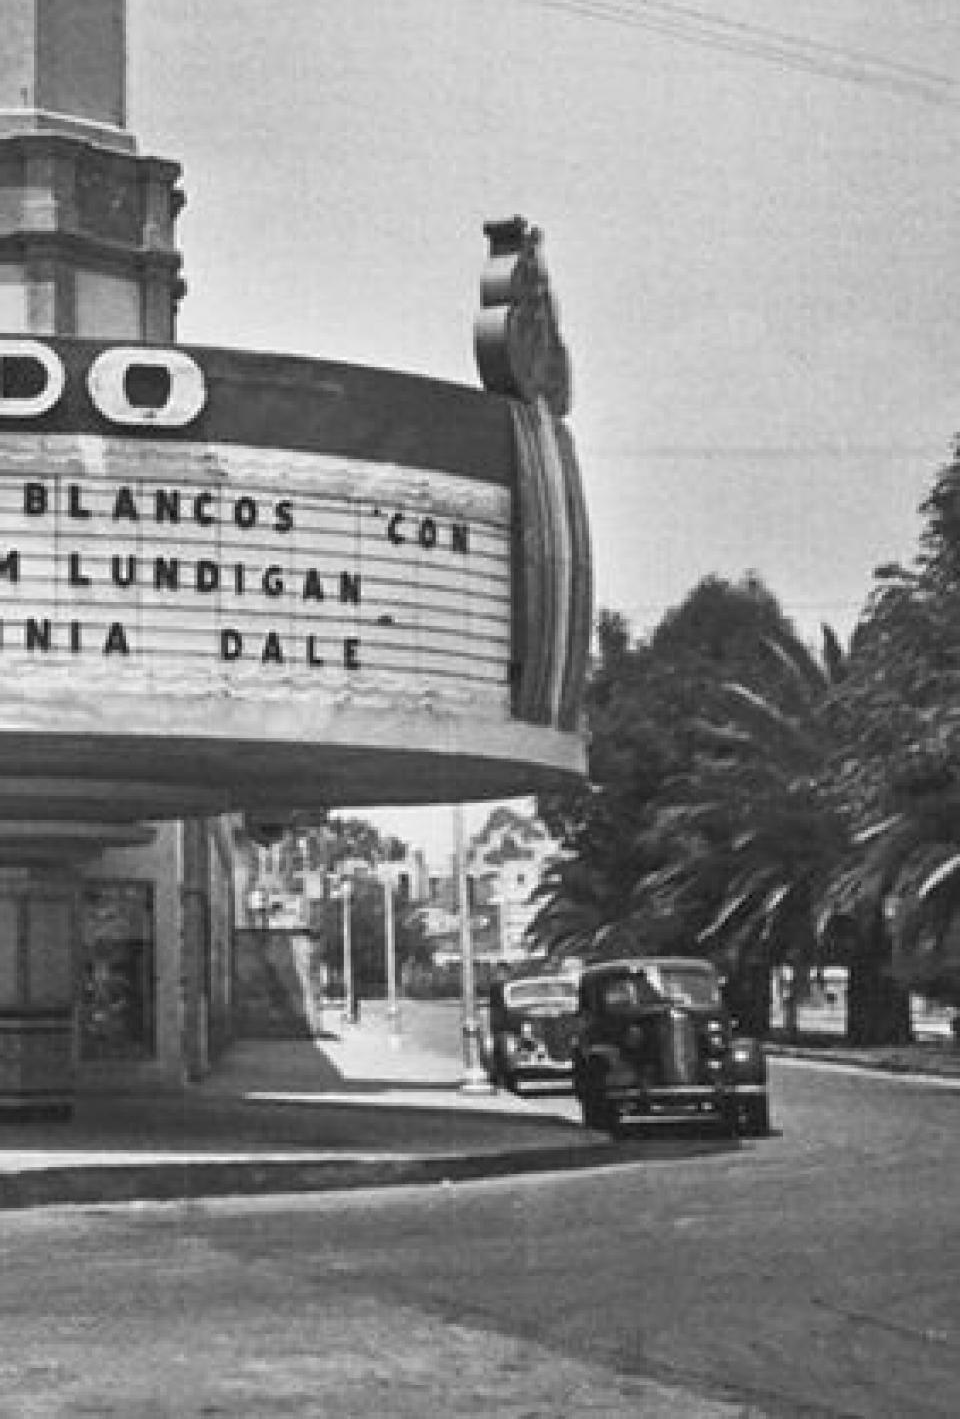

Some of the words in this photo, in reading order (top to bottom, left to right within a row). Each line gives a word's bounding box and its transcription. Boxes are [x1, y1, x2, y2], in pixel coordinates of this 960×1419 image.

[23, 482, 294, 532] BLANCOS
[68, 552, 363, 605] LUNDIGAN
[219, 626, 362, 670] DALE
